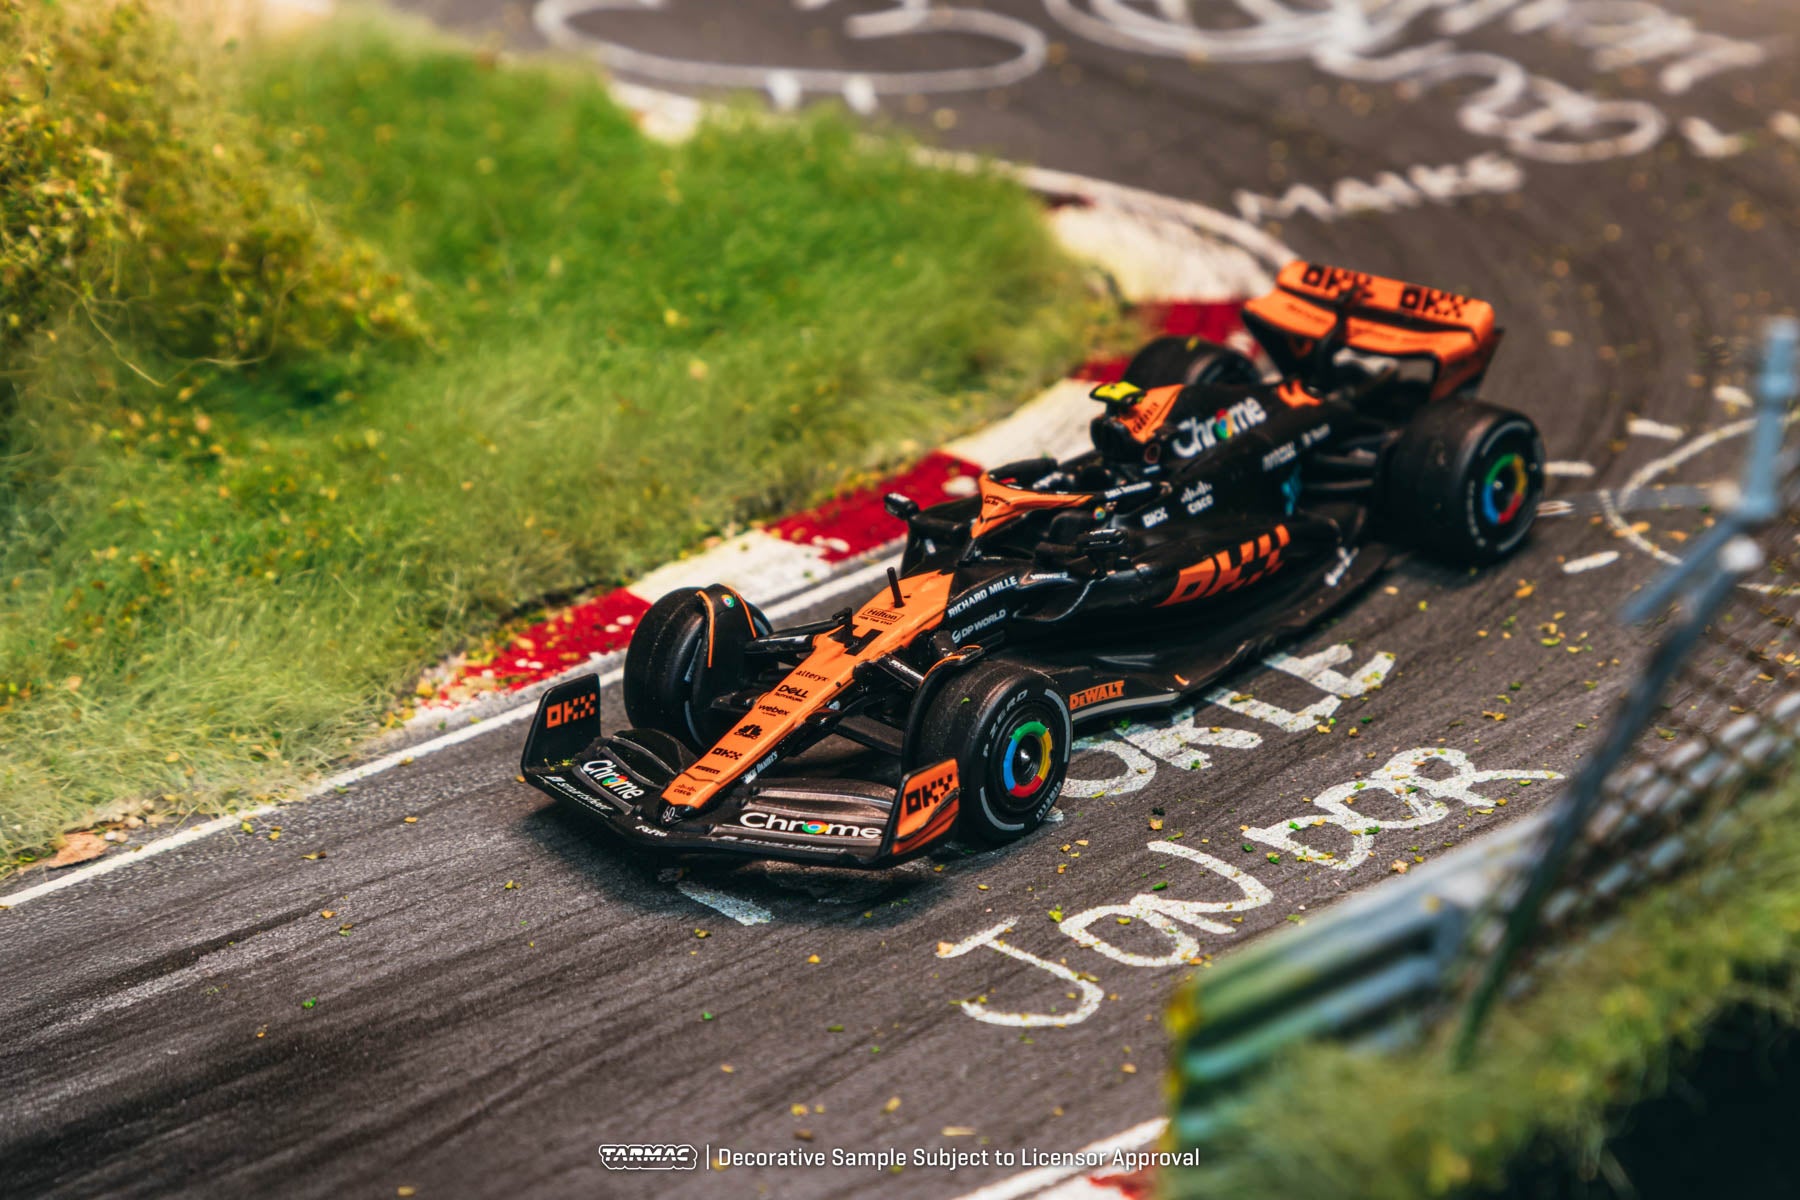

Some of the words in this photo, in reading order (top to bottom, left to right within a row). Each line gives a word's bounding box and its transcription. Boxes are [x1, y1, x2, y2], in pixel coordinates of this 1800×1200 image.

[1400, 284, 1469, 318] OKX
[947, 590, 988, 618] RICHARD
[988, 576, 1018, 595] MILLE
[867, 609, 898, 620] Hilton
[974, 609, 1007, 631] WORLD
[795, 670, 829, 682] alteryx
[547, 693, 596, 729] OKX
[758, 704, 790, 716] webex
[711, 747, 743, 760] OKX
[583, 760, 645, 799] Chrome
[906, 773, 953, 816] OKX
[739, 812, 882, 839] Chrome
